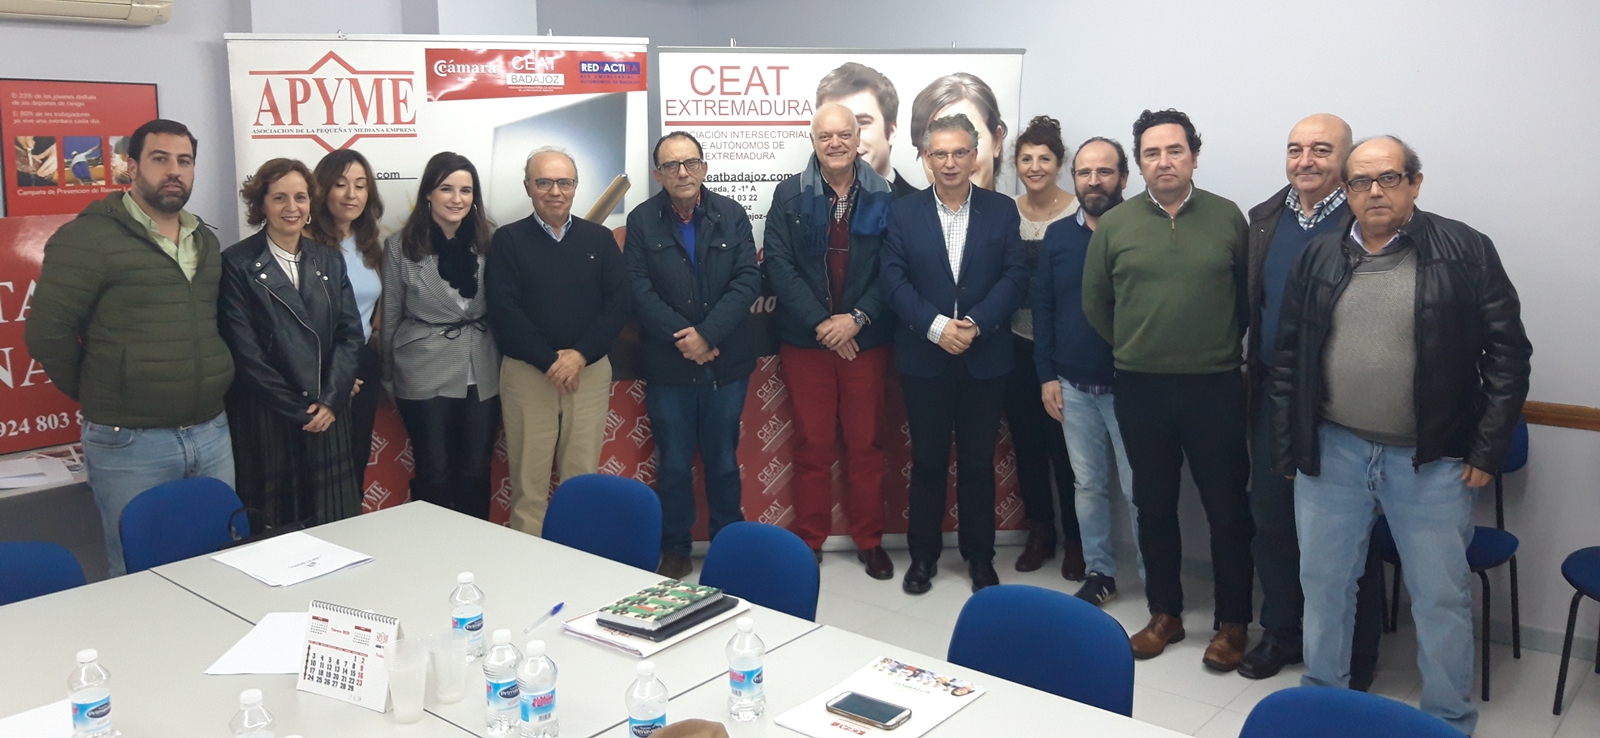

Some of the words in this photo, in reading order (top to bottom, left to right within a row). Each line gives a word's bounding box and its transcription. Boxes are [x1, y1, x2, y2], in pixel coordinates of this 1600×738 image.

[511, 56, 555, 71] CEAT
[511, 74, 560, 84] BADAJOZ
[690, 65, 789, 96] CEAT
[252, 77, 417, 126] APYME
[665, 99, 813, 116] EXTREMADURA
[689, 129, 728, 139] CIACIÓN
[730, 130, 810, 139] INTERSECTORIAL
[709, 140, 770, 150] AUTÓNOMOS
[772, 141, 785, 149] DE
[705, 152, 776, 161] EXTREMADURA
[704, 171, 793, 183] eatbadajoz.com
[56, 186, 90, 195] Prevención
[756, 373, 781, 399] CEAT
[36, 412, 70, 432] 803
[756, 413, 781, 441] CEAT
[757, 456, 782, 483] CEAT
[995, 491, 1018, 516] CEAT
